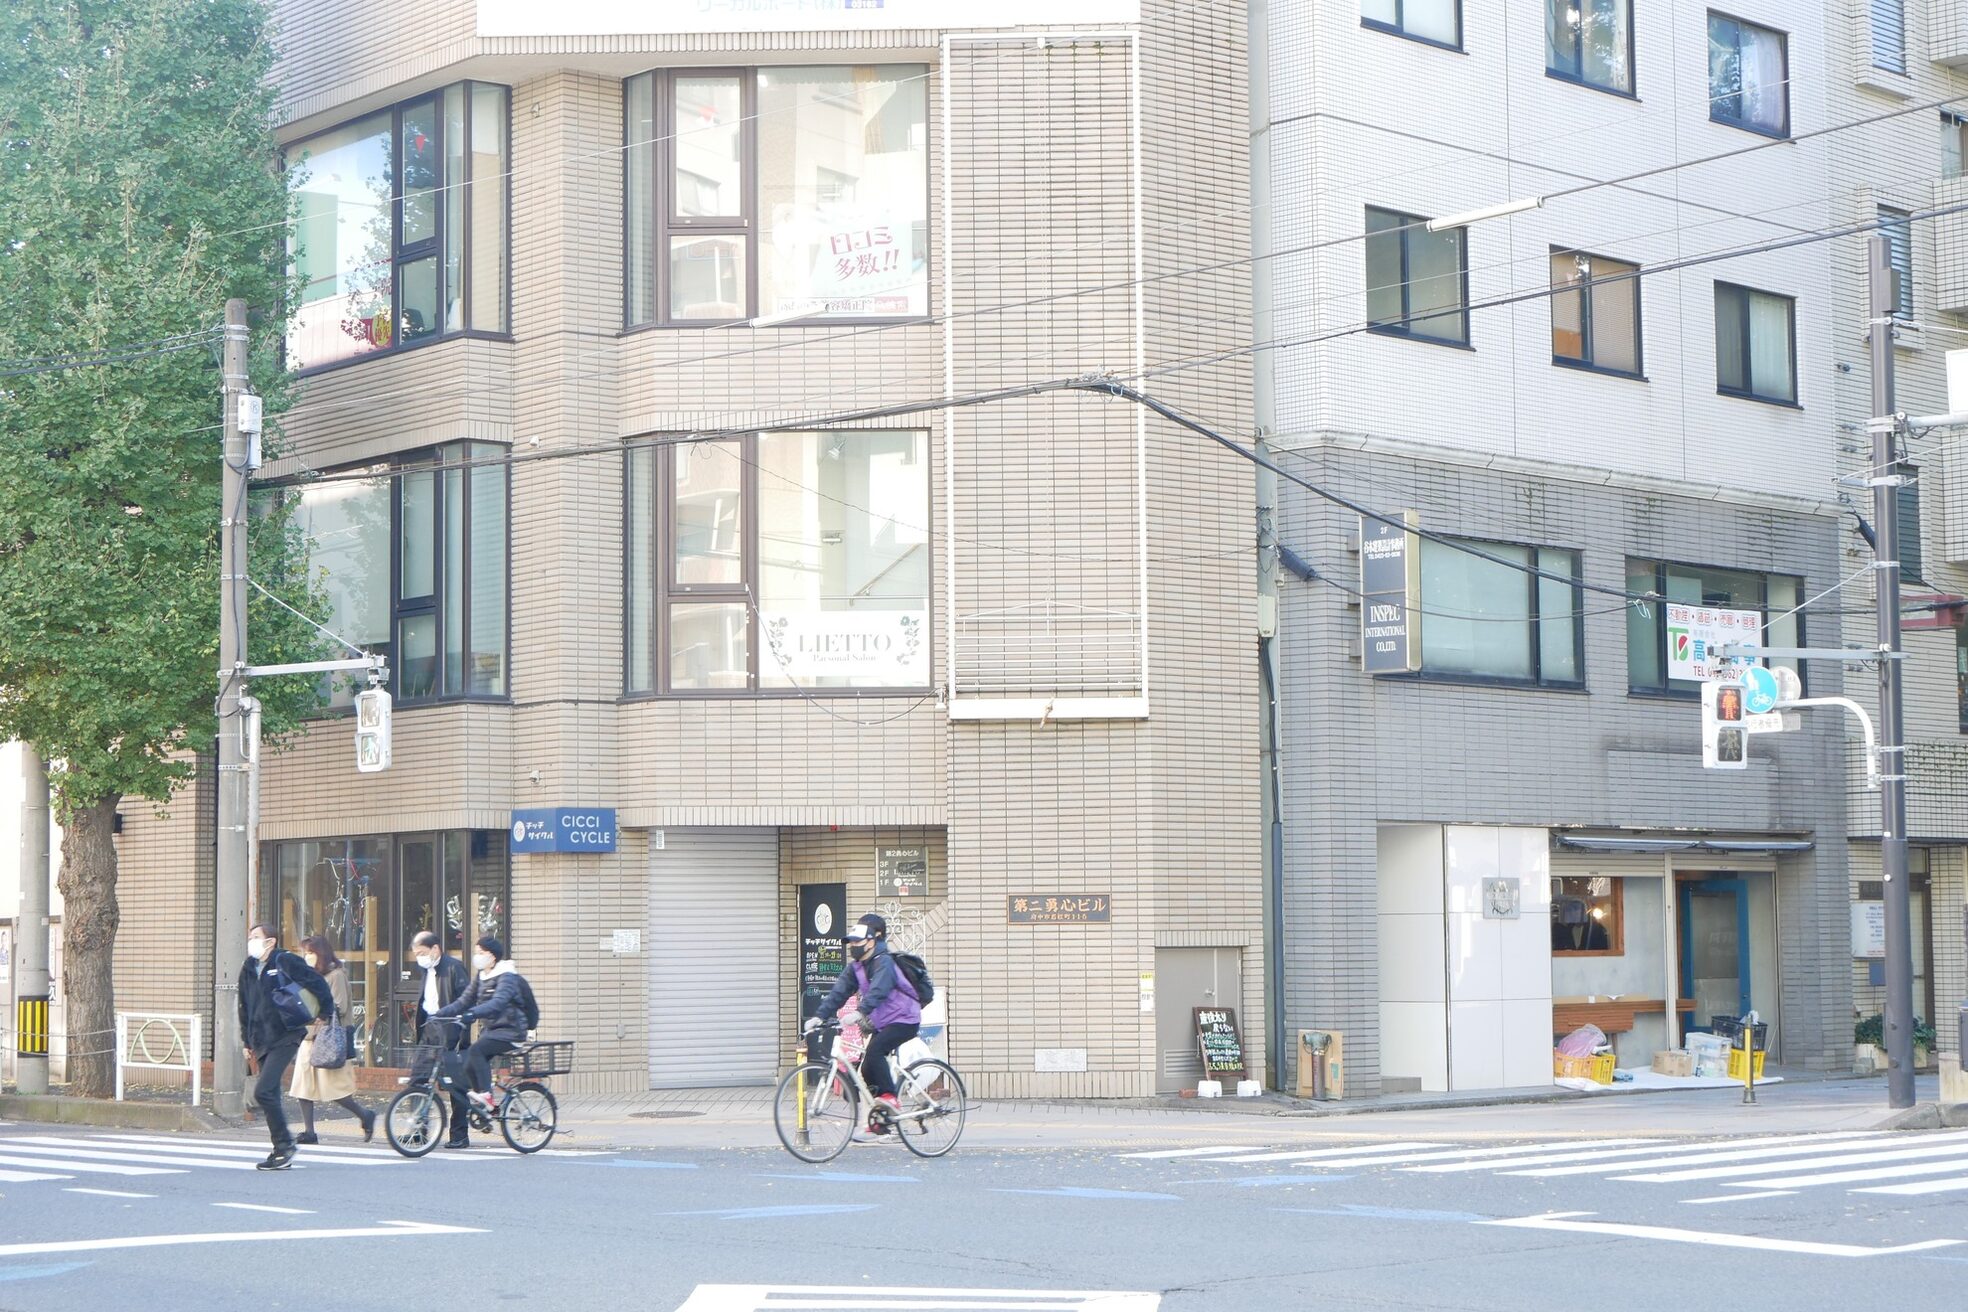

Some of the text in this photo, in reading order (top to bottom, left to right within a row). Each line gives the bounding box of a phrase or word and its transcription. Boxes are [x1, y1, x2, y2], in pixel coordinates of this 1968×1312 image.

[1370, 603, 1401, 623] INSPEC
[1365, 624, 1406, 638] INTERNATIONAL
[799, 634, 891, 653] LIETTO
[1693, 665, 1705, 677] TEL
[561, 815, 600, 828] CICCI
[528, 832, 554, 840] サイクル
[570, 831, 611, 844] CYCLE
[1013, 897, 1107, 913] 第二勇心ビル
[805, 938, 842, 946] チッチサイクル
